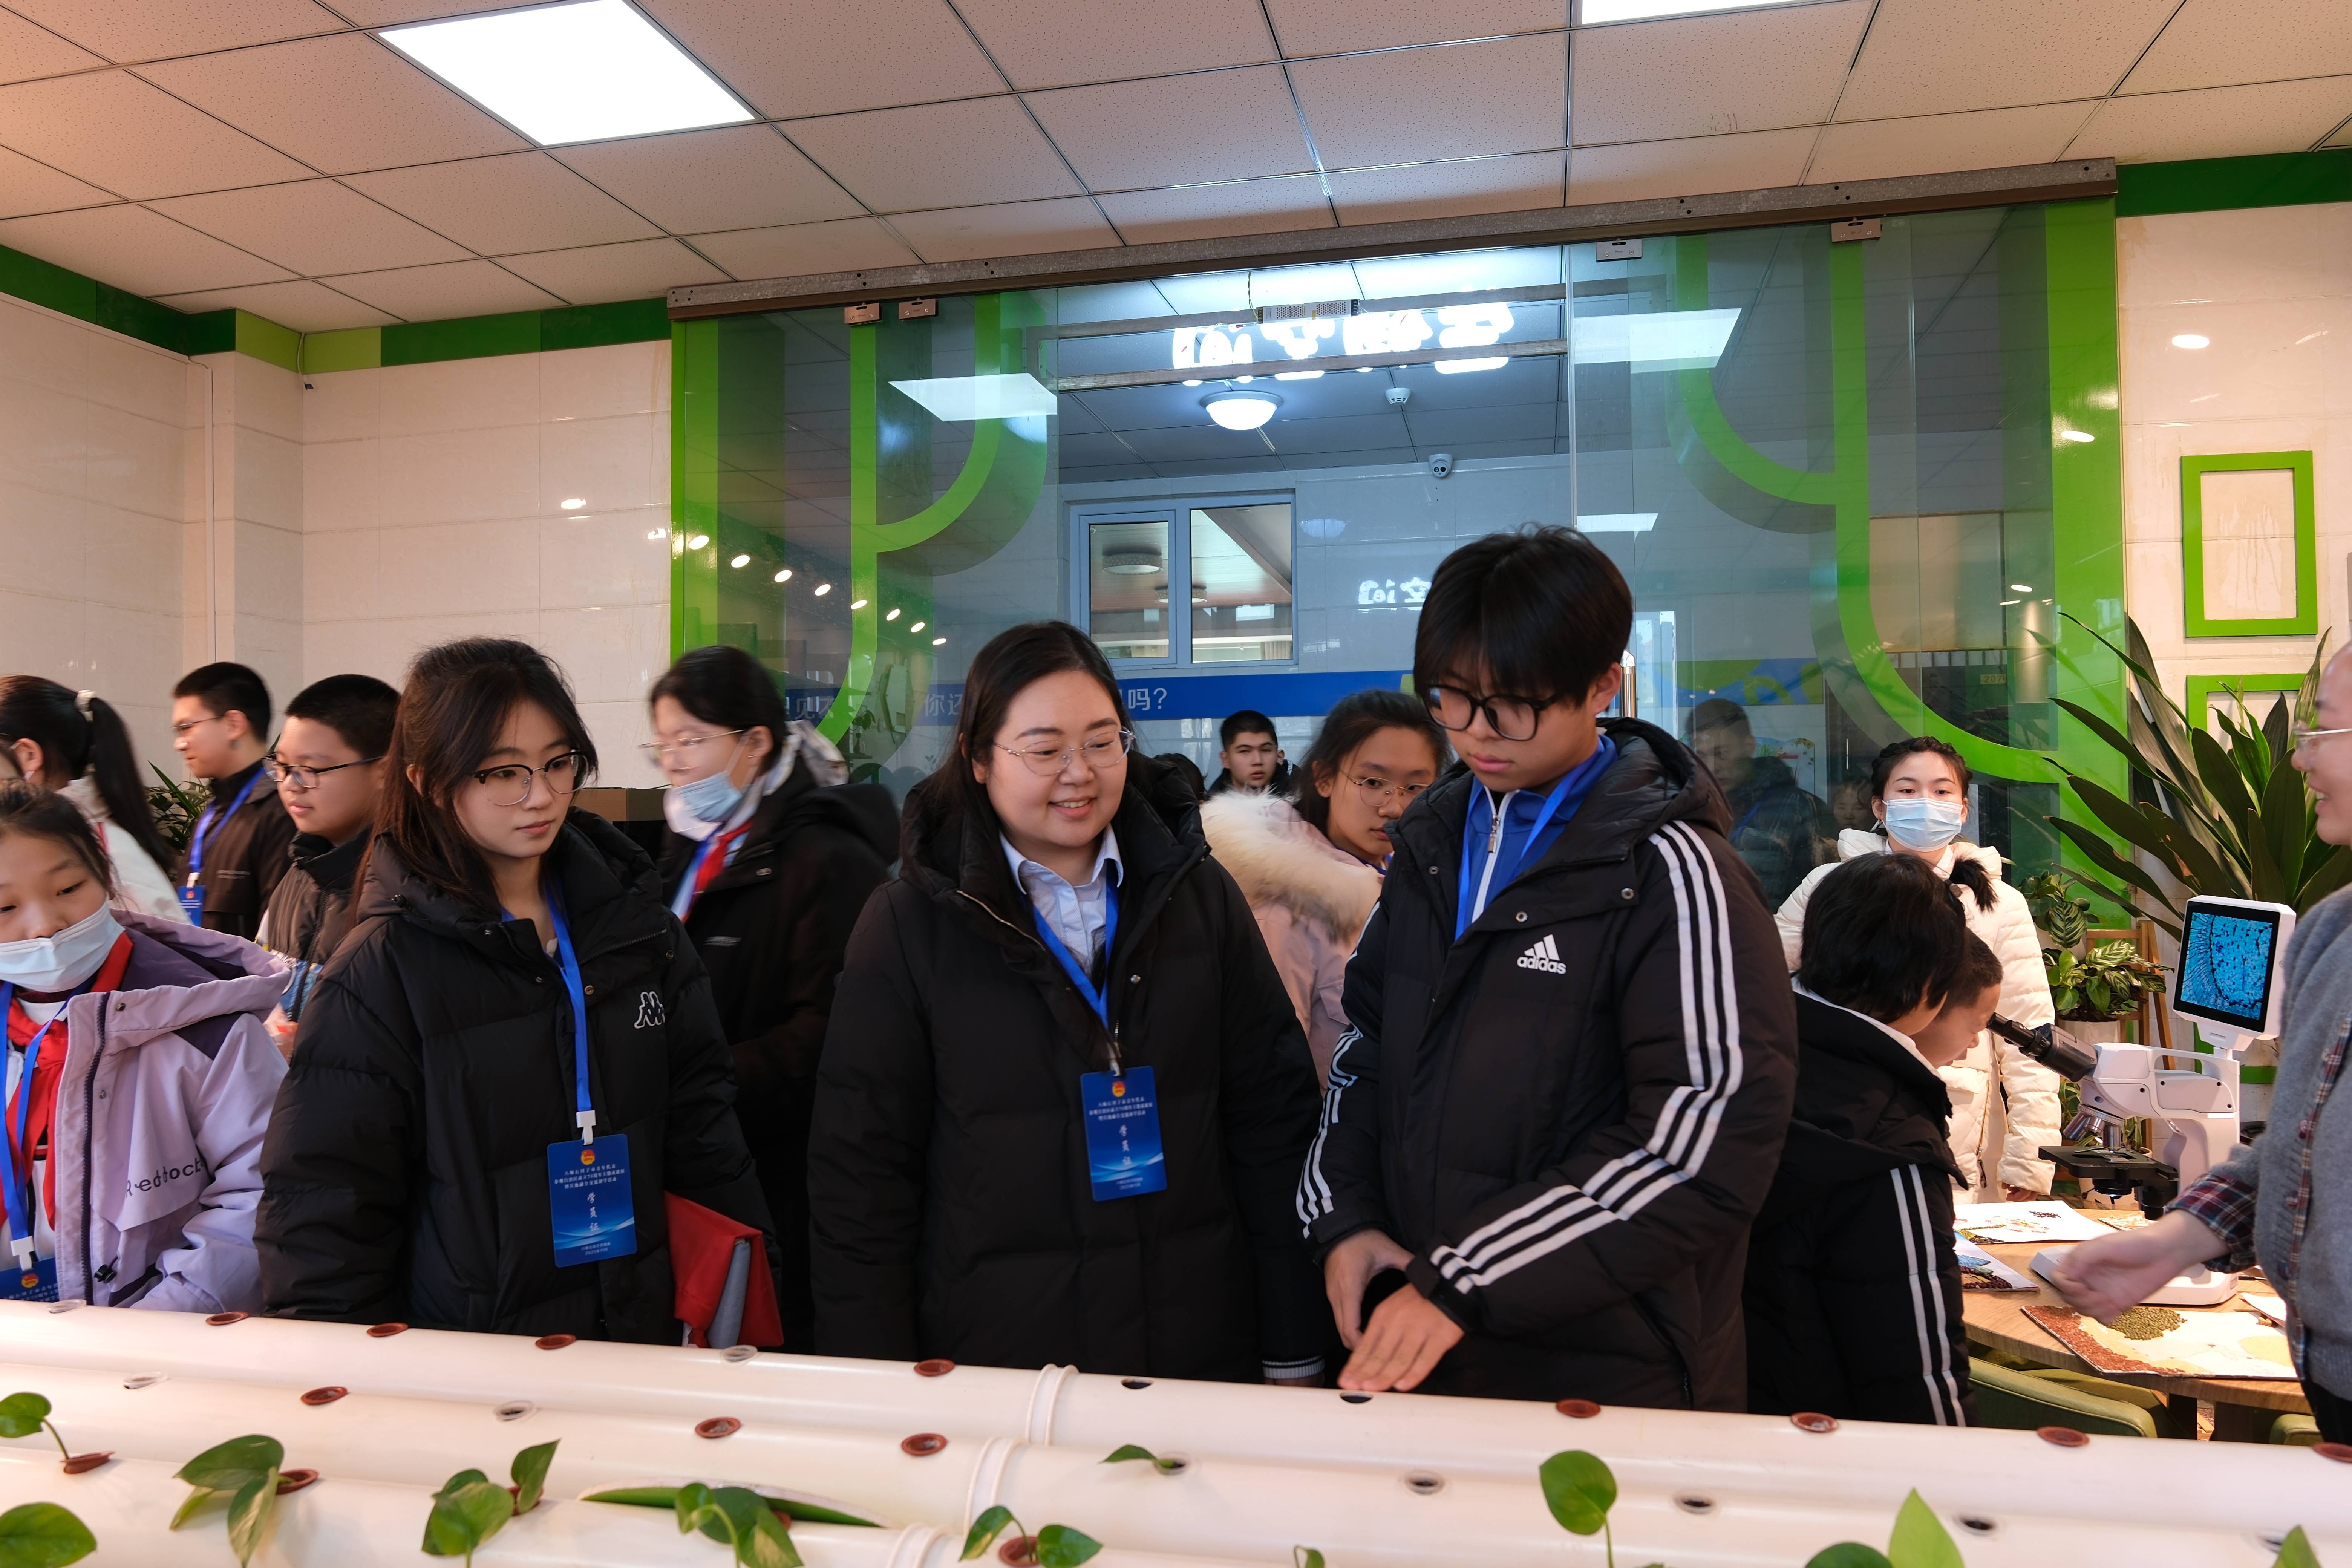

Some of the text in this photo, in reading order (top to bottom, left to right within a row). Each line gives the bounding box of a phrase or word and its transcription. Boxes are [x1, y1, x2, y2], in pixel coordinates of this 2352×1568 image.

[1119, 688, 1167, 710] 吗?
[1517, 956, 1567, 974] adidas
[587, 1192, 599, 1232] 学员证
